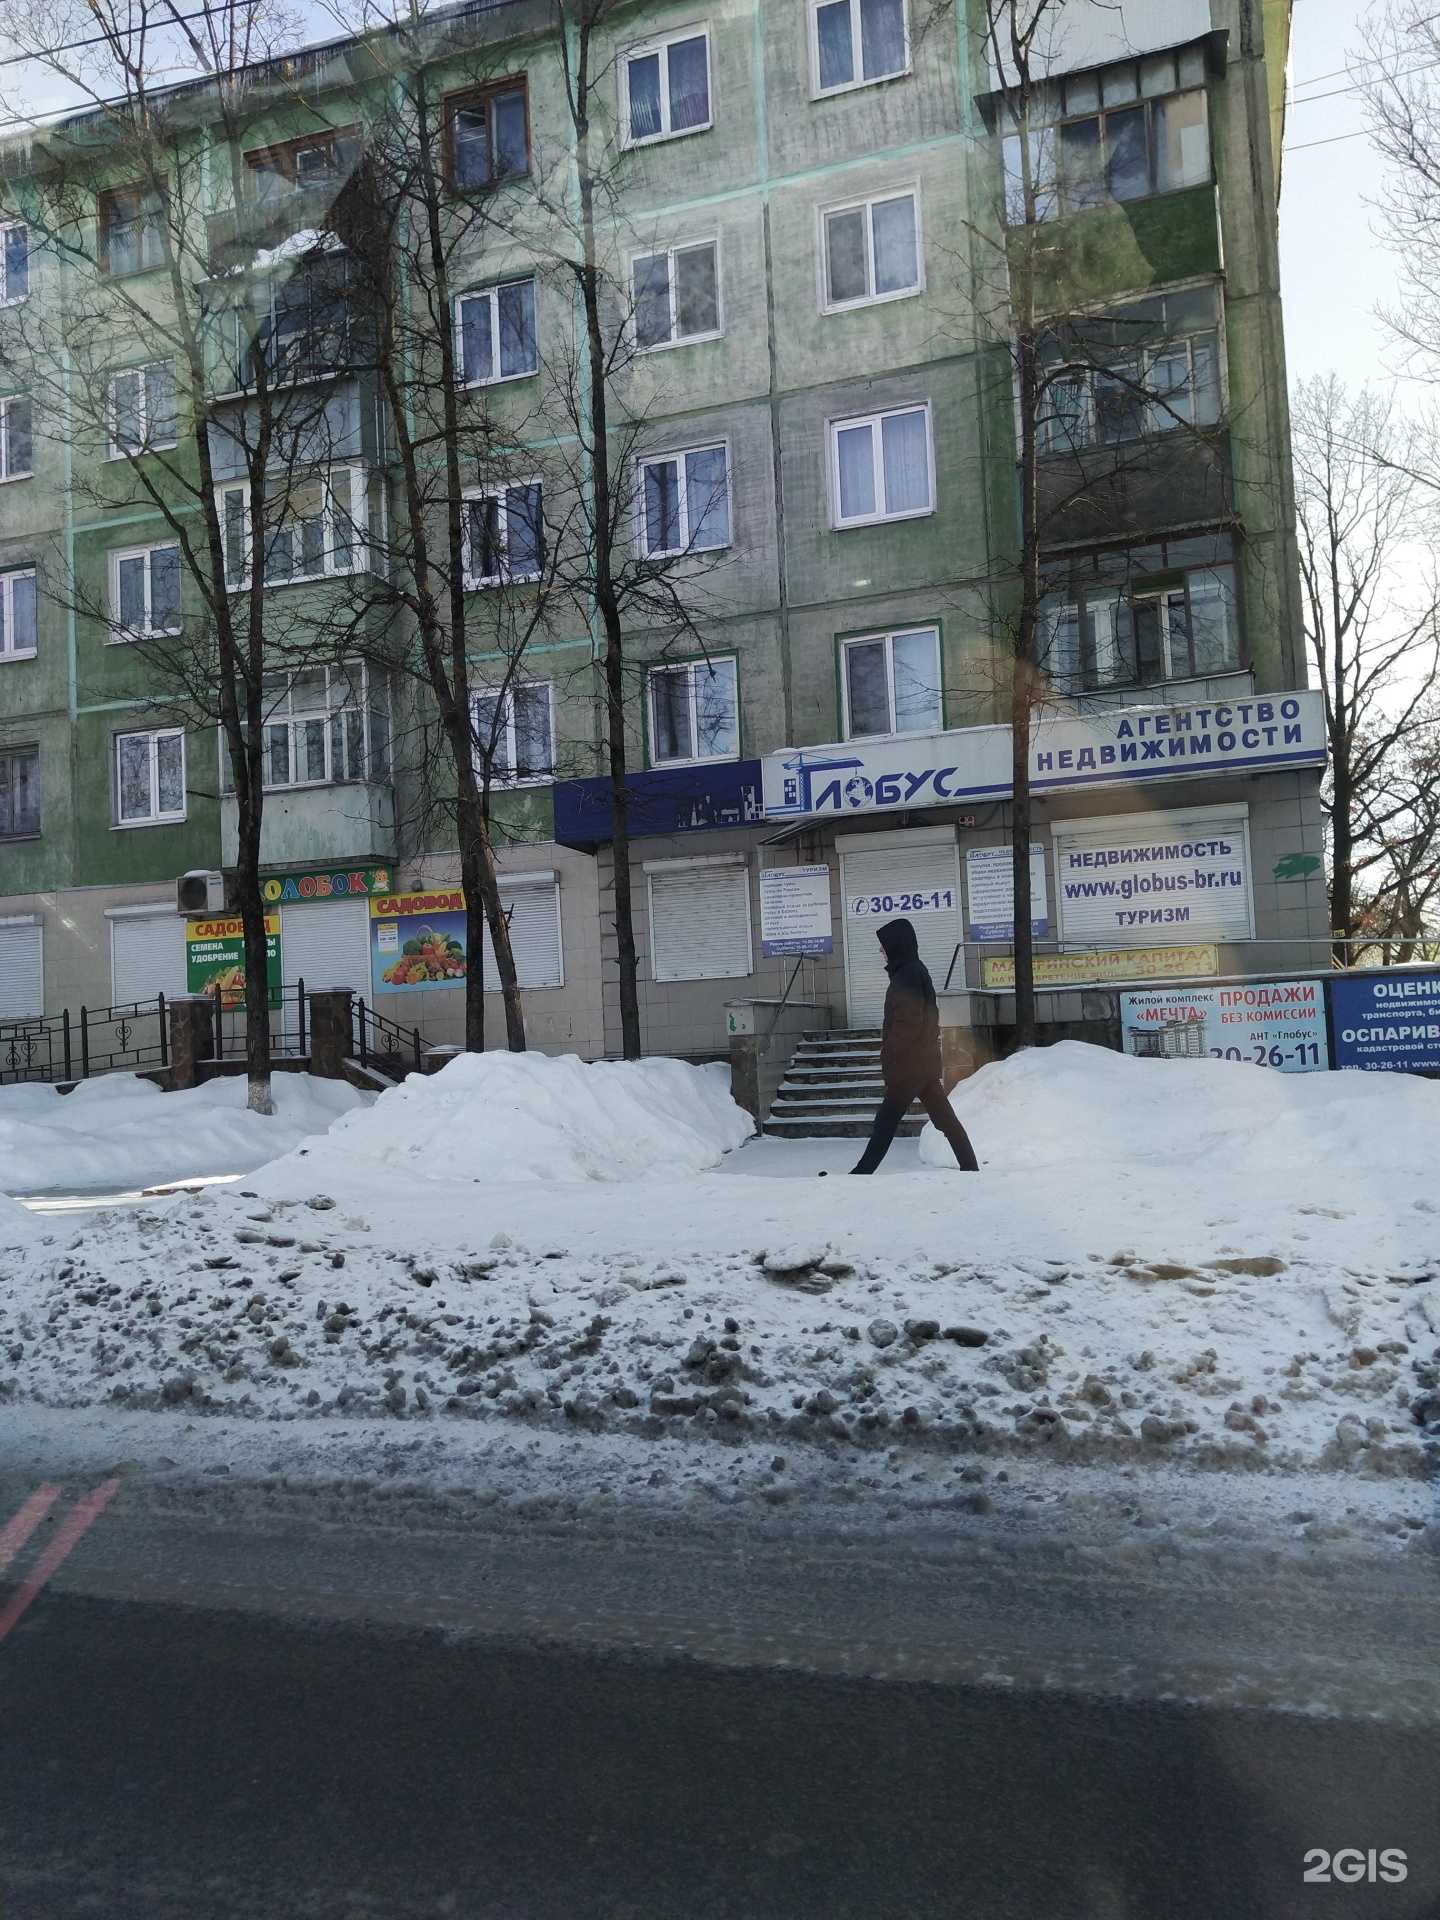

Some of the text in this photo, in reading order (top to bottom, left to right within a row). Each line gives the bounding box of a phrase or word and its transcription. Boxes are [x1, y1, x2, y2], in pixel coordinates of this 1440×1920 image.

[1117, 699, 1300, 738] АГЕНТСТВО
[1037, 723, 1302, 771] НЕДВИЖИМОСТИ
[1069, 841, 1232, 868] НЕДВИЖИМОСТЬ
[1065, 869, 1242, 899] www.globus-br.ru
[376, 892, 464, 914] САДОВОД
[871, 890, 952, 913] 30-26-11
[1115, 906, 1190, 926] ТУРИЗМ
[191, 942, 224, 952] СЕМЕНА
[191, 952, 239, 963] УДОБРЕНИЕ
[991, 953, 1121, 974] МАЕРИНСКИЙ
[1128, 993, 1214, 1006] Жилой комплекс
[1219, 986, 1316, 1007] ПРОДАЖИ
[1136, 1006, 1208, 1022] «МЕЧТА»
[1221, 1007, 1317, 1025] БЕЗ КОМИССИИ
[1362, 1009, 1426, 1020] транспорта,
[1250, 1029, 1318, 1041] АНТ «Глобус»
[1356, 1042, 1424, 1053] кадастровой
[1365, 1061, 1408, 1070] 30-26-11
